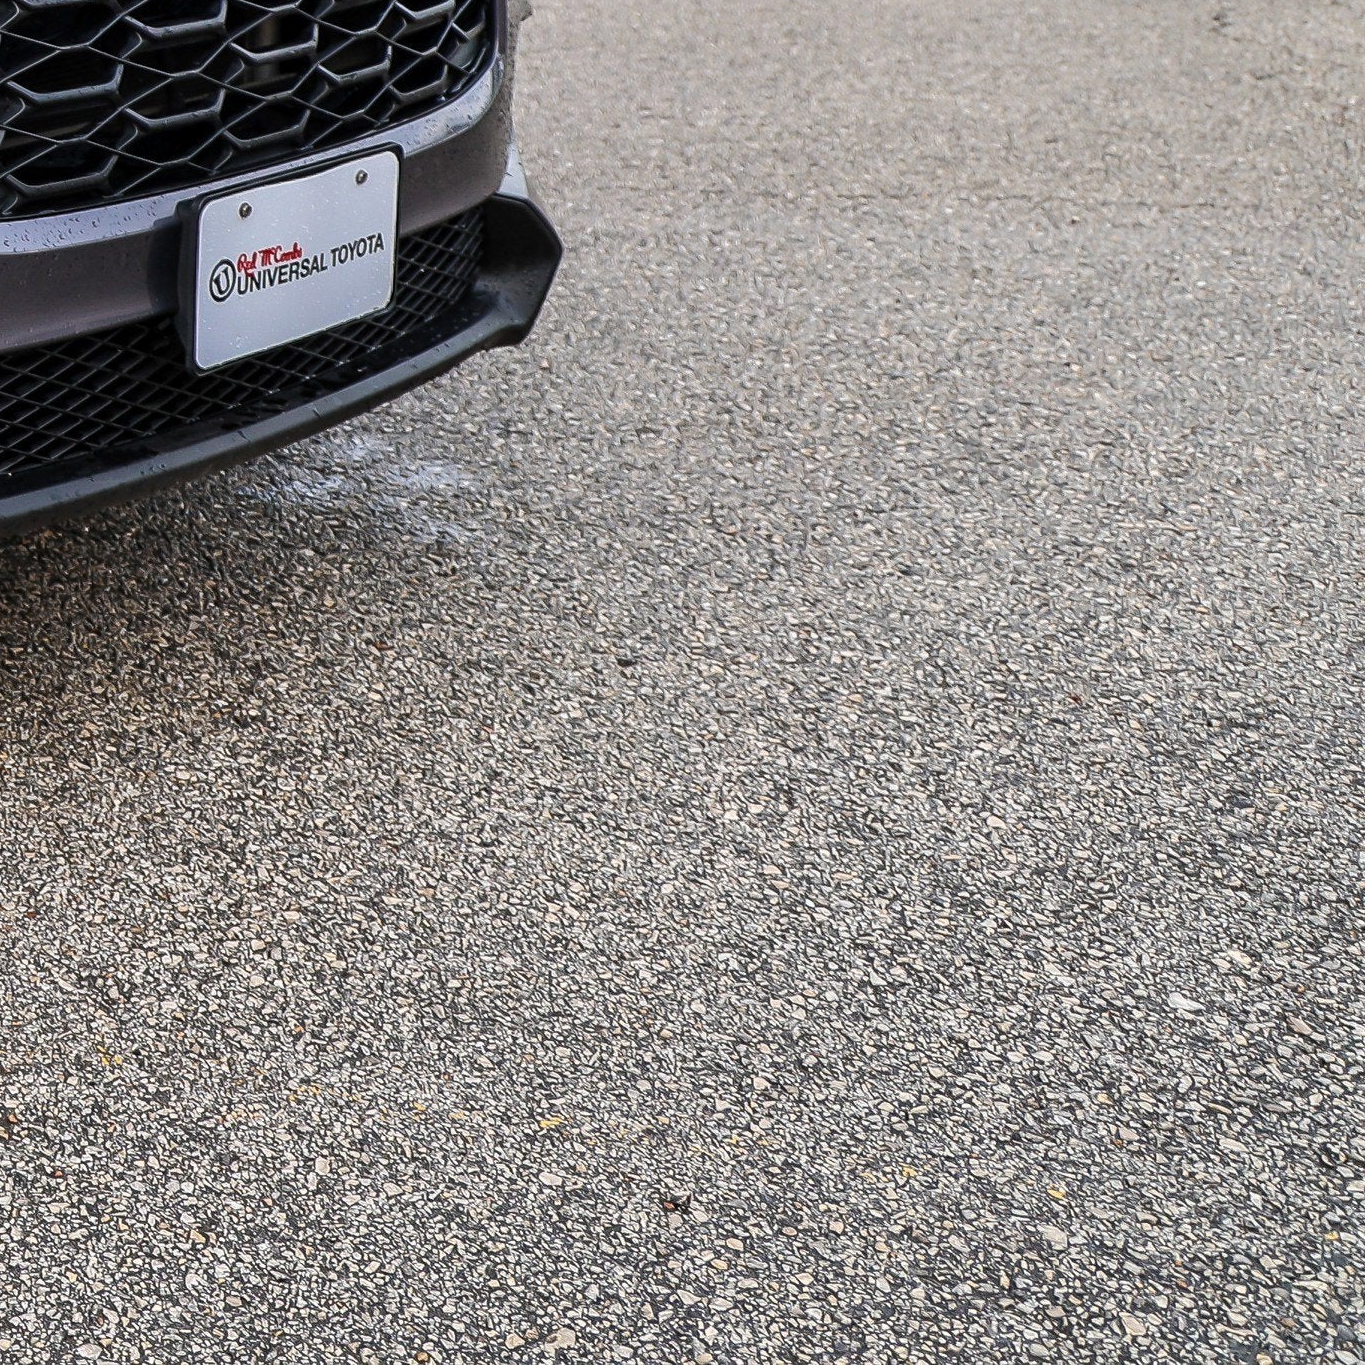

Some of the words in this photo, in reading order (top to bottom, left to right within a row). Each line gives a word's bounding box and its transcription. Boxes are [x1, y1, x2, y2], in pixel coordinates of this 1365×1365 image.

[237, 252, 328, 295] UNIVERSAL
[331, 232, 385, 267] TOYOTA
[237, 252, 257, 277] Red
